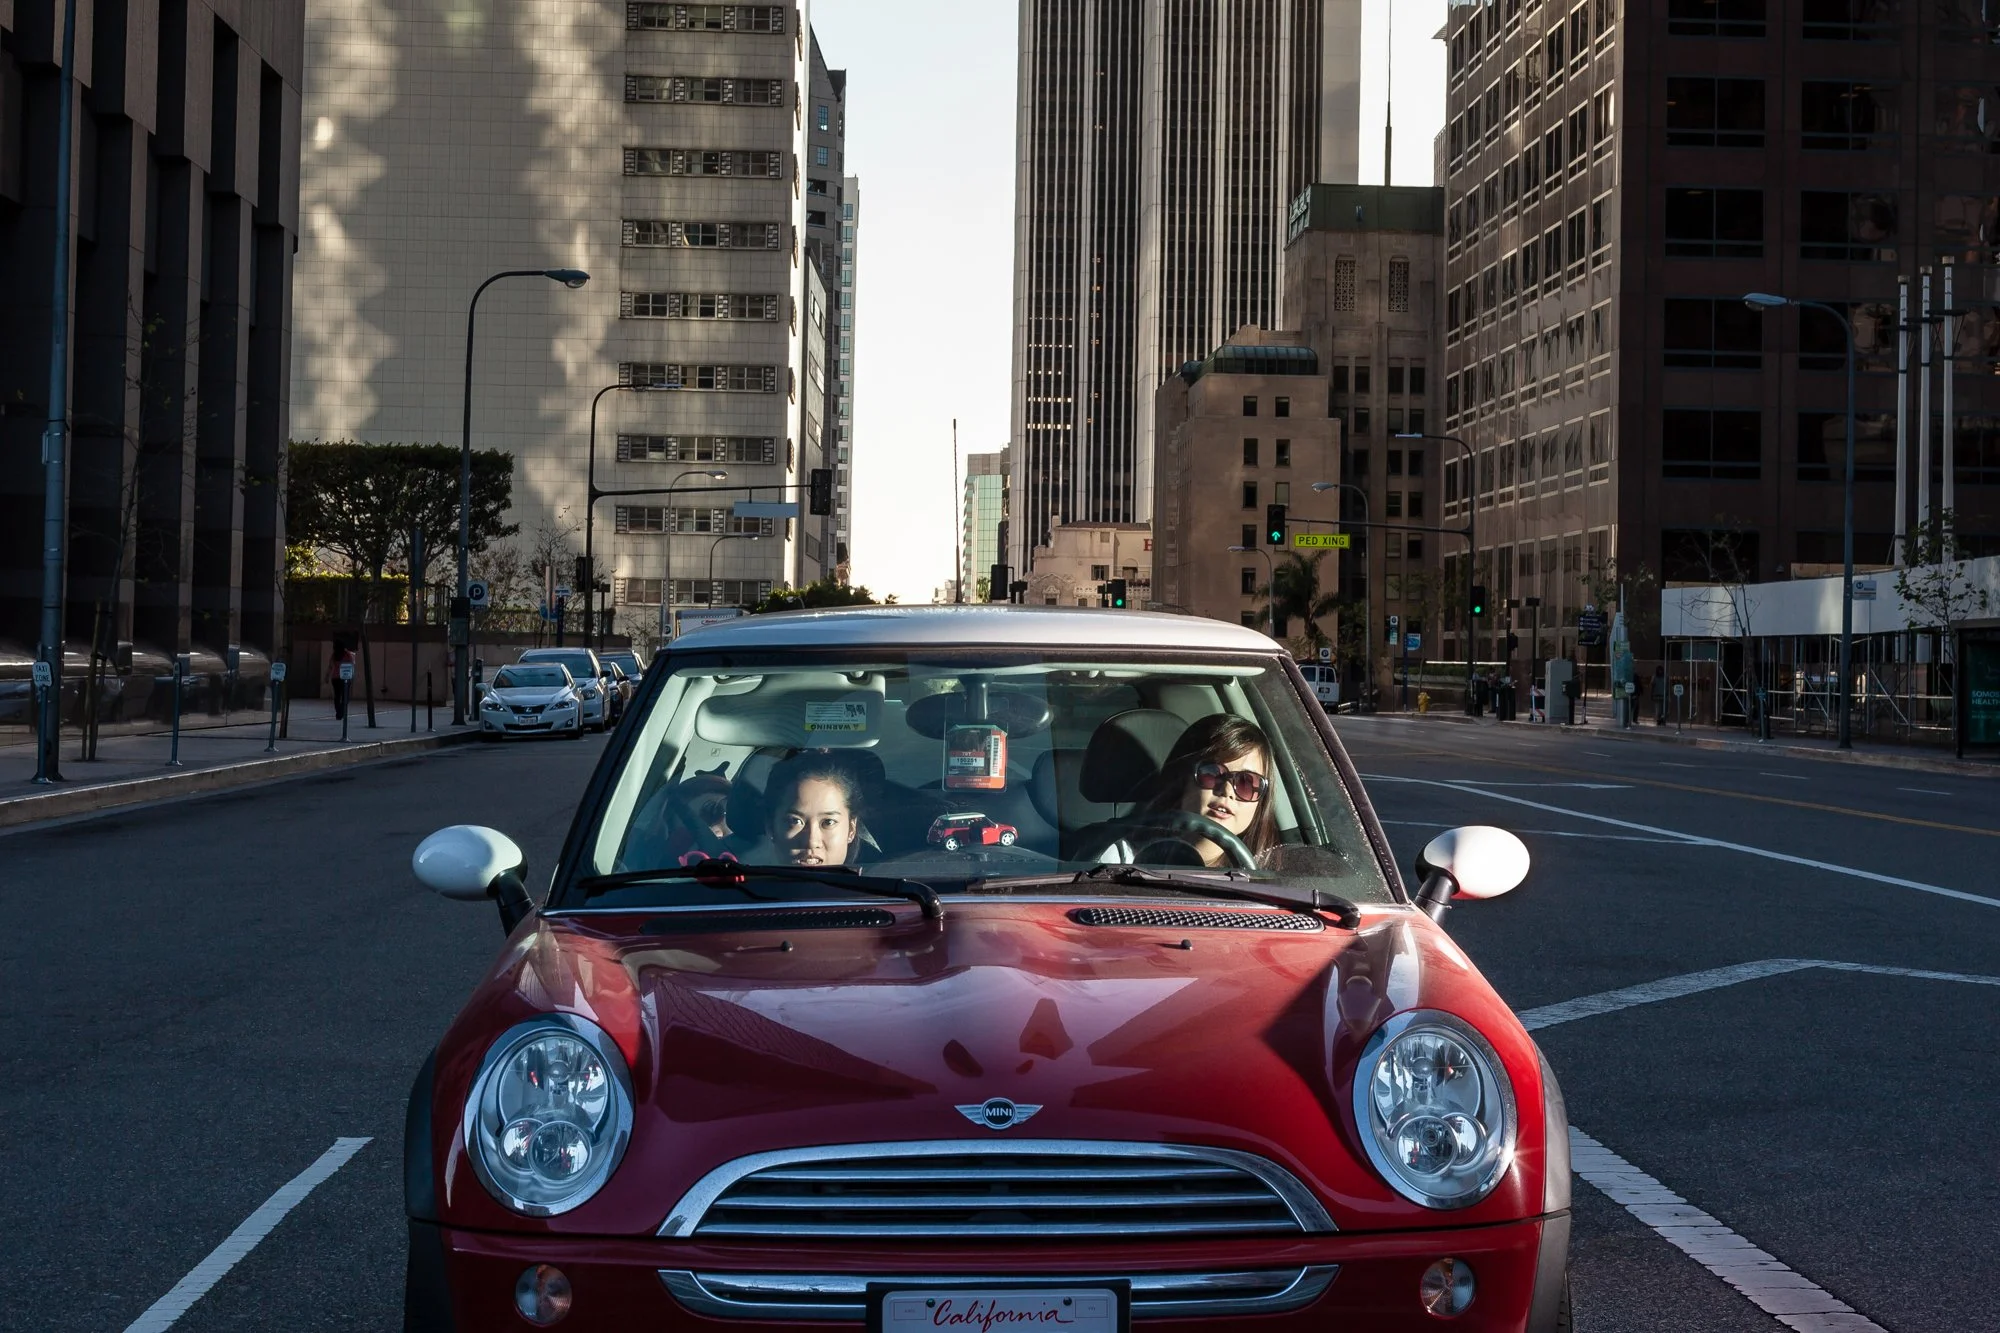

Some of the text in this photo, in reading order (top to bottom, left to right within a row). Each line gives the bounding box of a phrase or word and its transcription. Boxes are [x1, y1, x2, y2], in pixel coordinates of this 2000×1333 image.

[1298, 536, 1345, 546] PED XING
[985, 1107, 1013, 1117] MINI
[934, 1299, 1074, 1333] California
